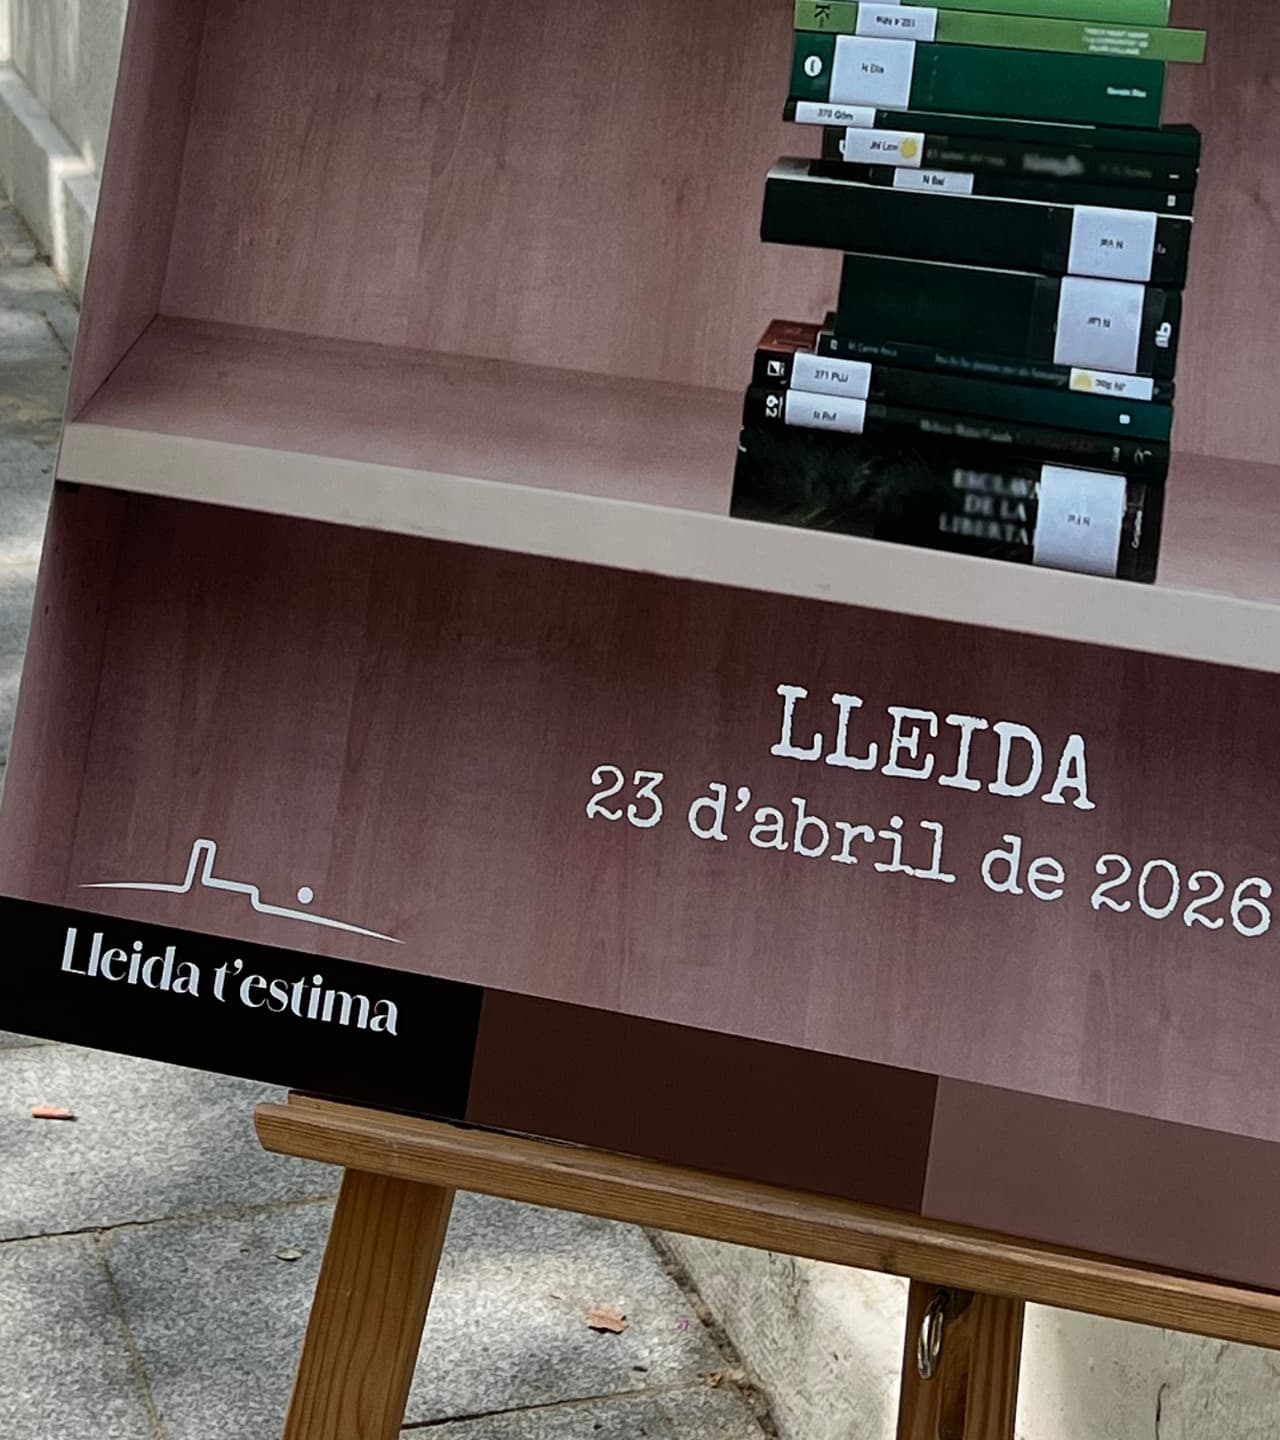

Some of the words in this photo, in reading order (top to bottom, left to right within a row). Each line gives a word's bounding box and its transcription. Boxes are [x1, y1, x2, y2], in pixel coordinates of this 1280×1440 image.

[939, 513, 1036, 546] LIBERTA
[771, 684, 1095, 809] LLEIDA
[586, 765, 663, 828] 23
[688, 781, 956, 883] d'abril
[981, 834, 1064, 900] de
[1091, 854, 1272, 937] 2026
[61, 927, 200, 997] Lleida
[213, 959, 399, 1036] t'estima
